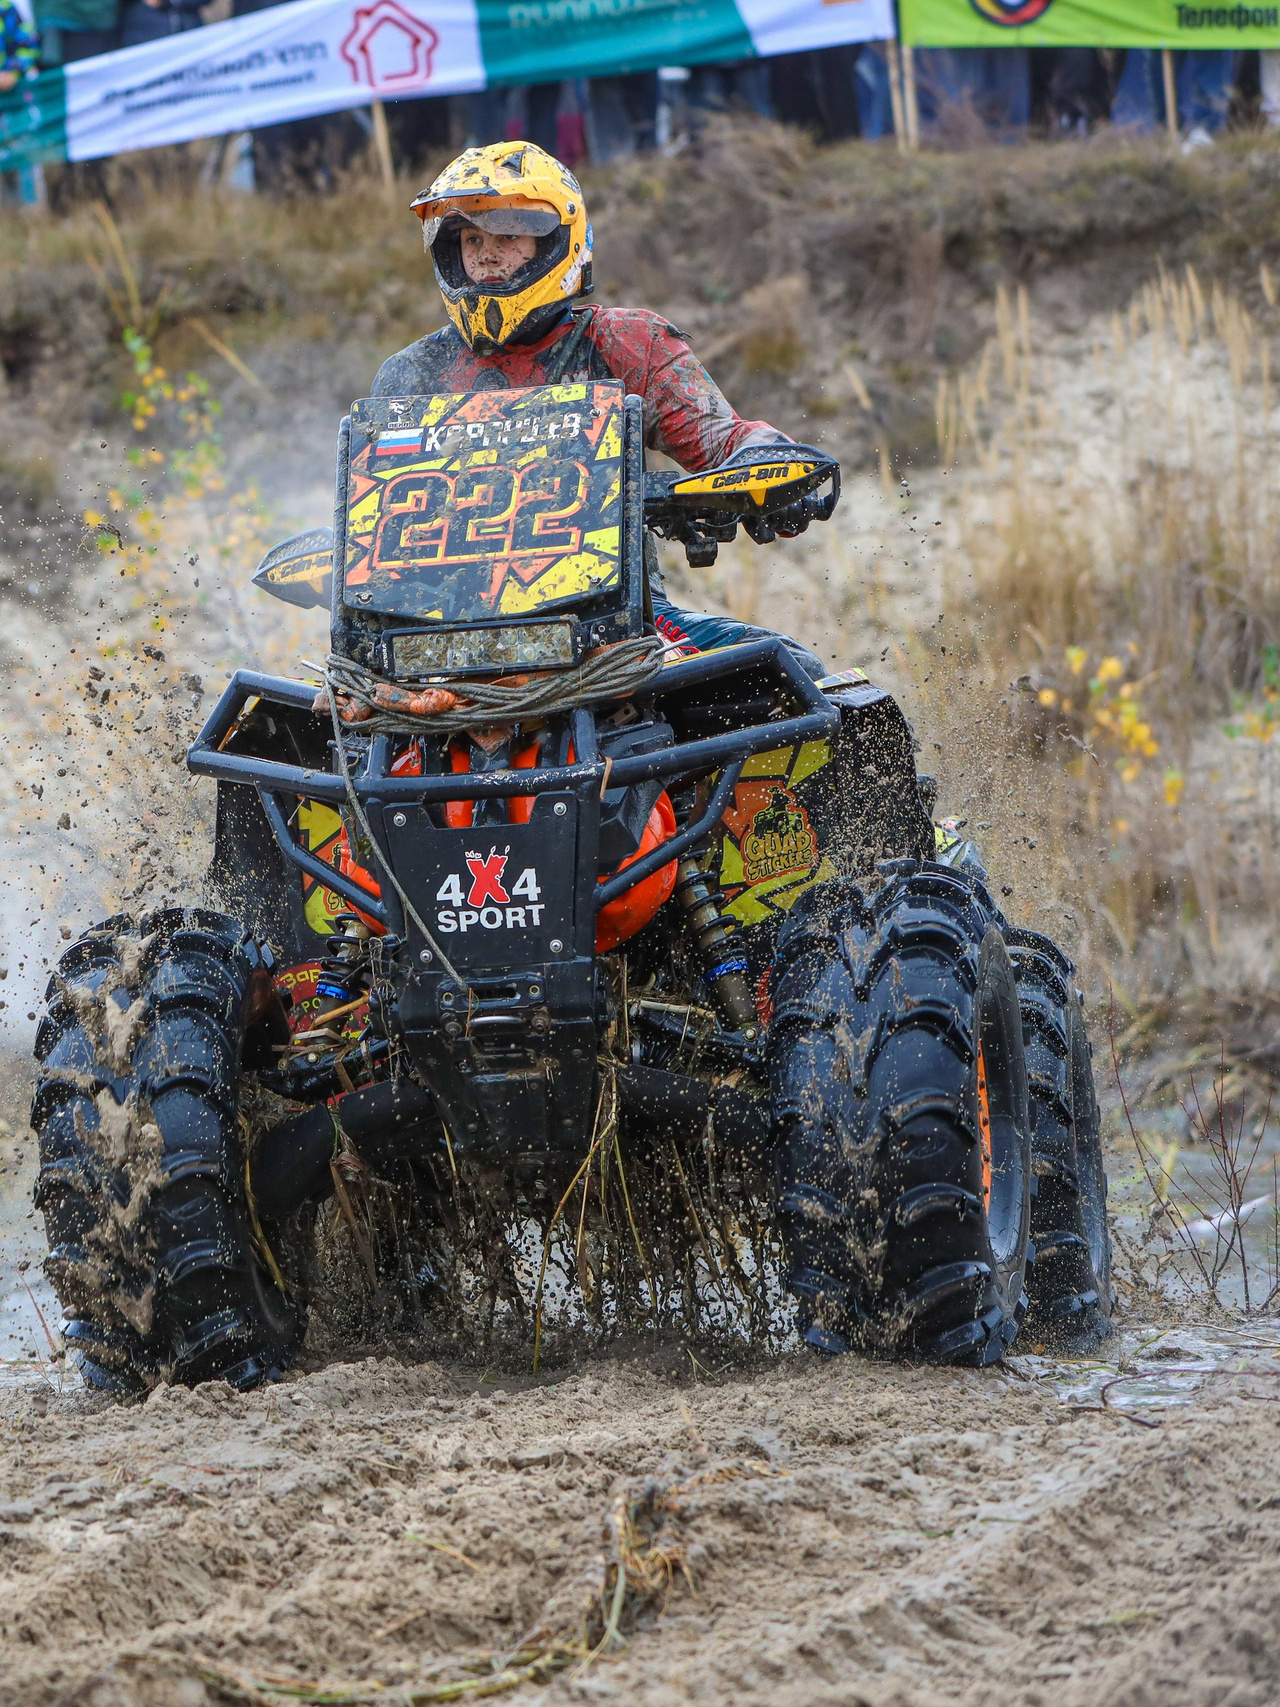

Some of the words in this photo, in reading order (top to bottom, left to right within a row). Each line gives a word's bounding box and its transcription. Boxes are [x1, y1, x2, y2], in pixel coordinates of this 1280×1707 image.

[1174, 3, 1279, 31] Телефон
[712, 466, 789, 488] can-am
[372, 460, 592, 569] 222
[280, 554, 333, 578] can-a
[746, 831, 812, 861] QUAD
[748, 850, 814, 880] STICKERS
[437, 904, 545, 933] SPORT
